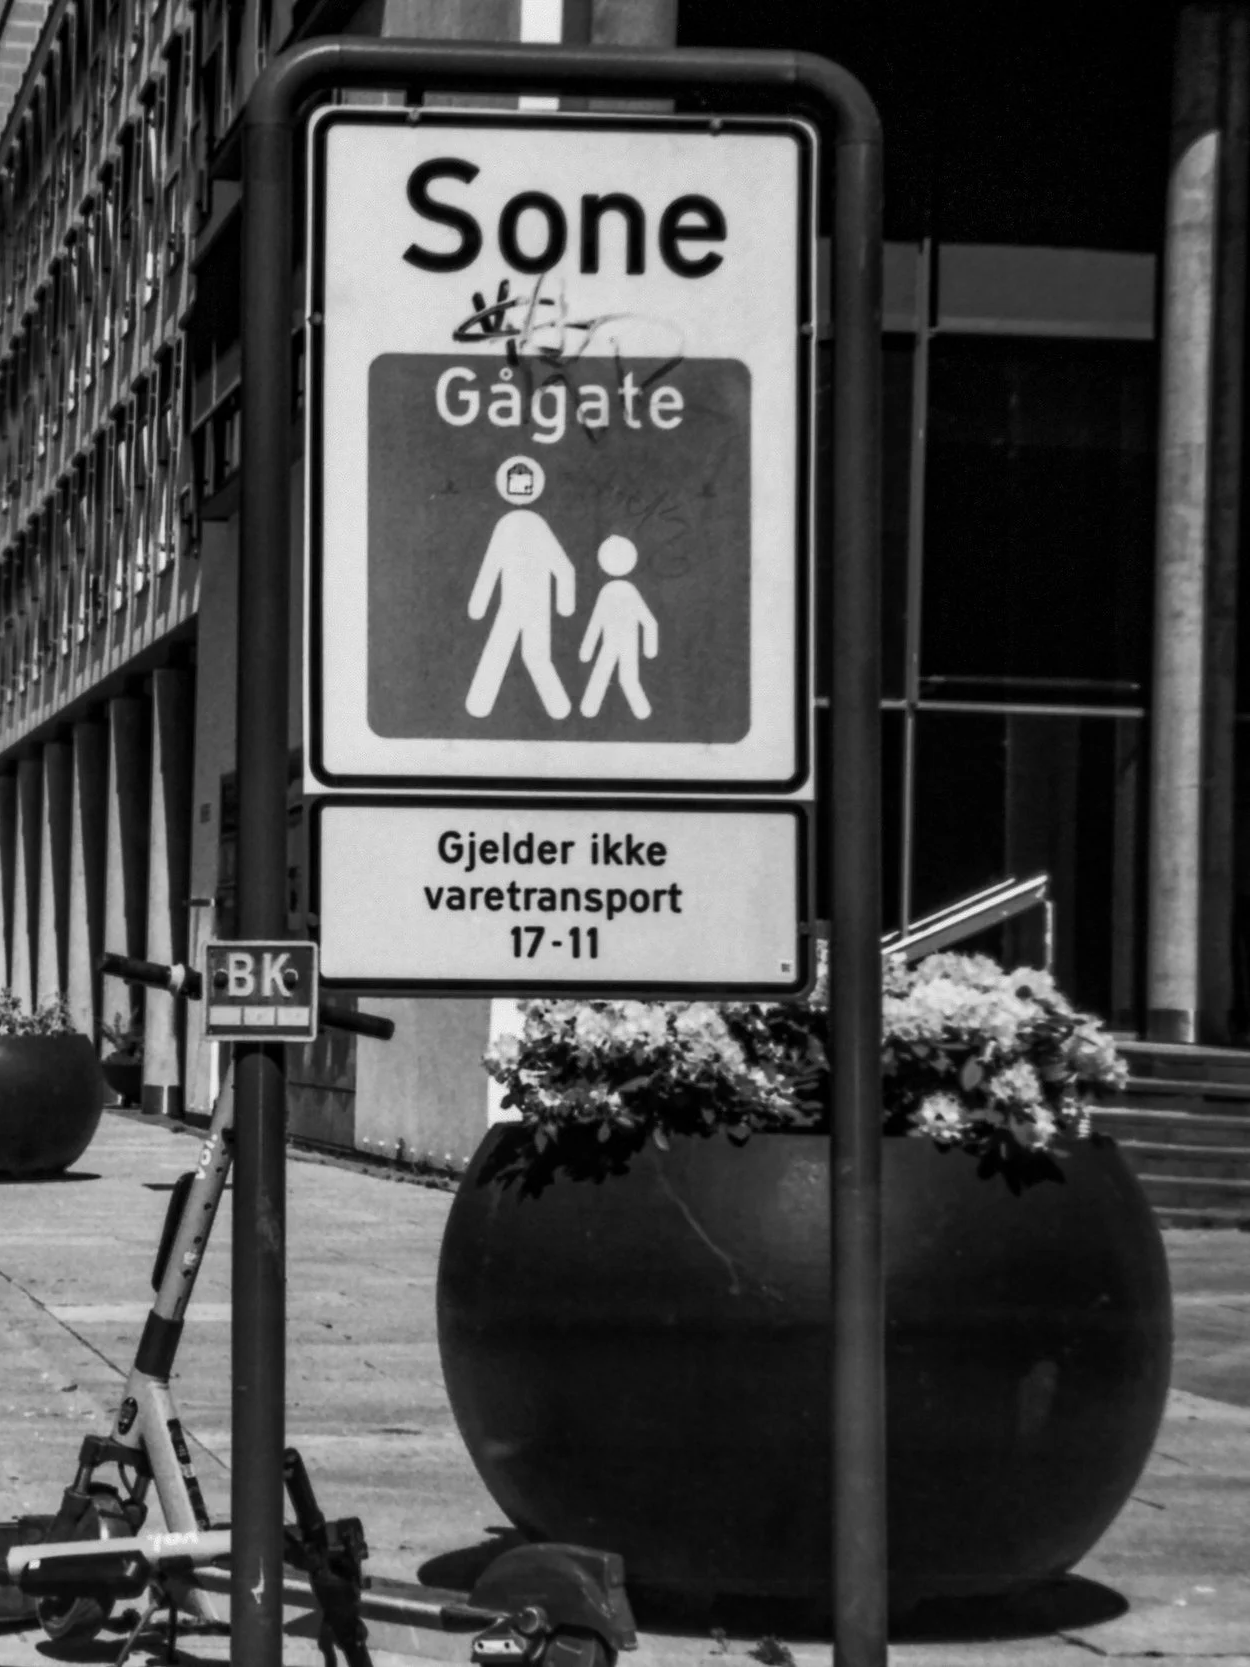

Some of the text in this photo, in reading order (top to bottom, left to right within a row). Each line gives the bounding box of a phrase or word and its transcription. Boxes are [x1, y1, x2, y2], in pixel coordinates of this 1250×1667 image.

[402, 157, 727, 279] Sone
[436, 366, 684, 444] Gågate
[437, 830, 668, 873] Gjelder ikke
[423, 880, 683, 921] varetransport
[228, 952, 293, 997] BK
